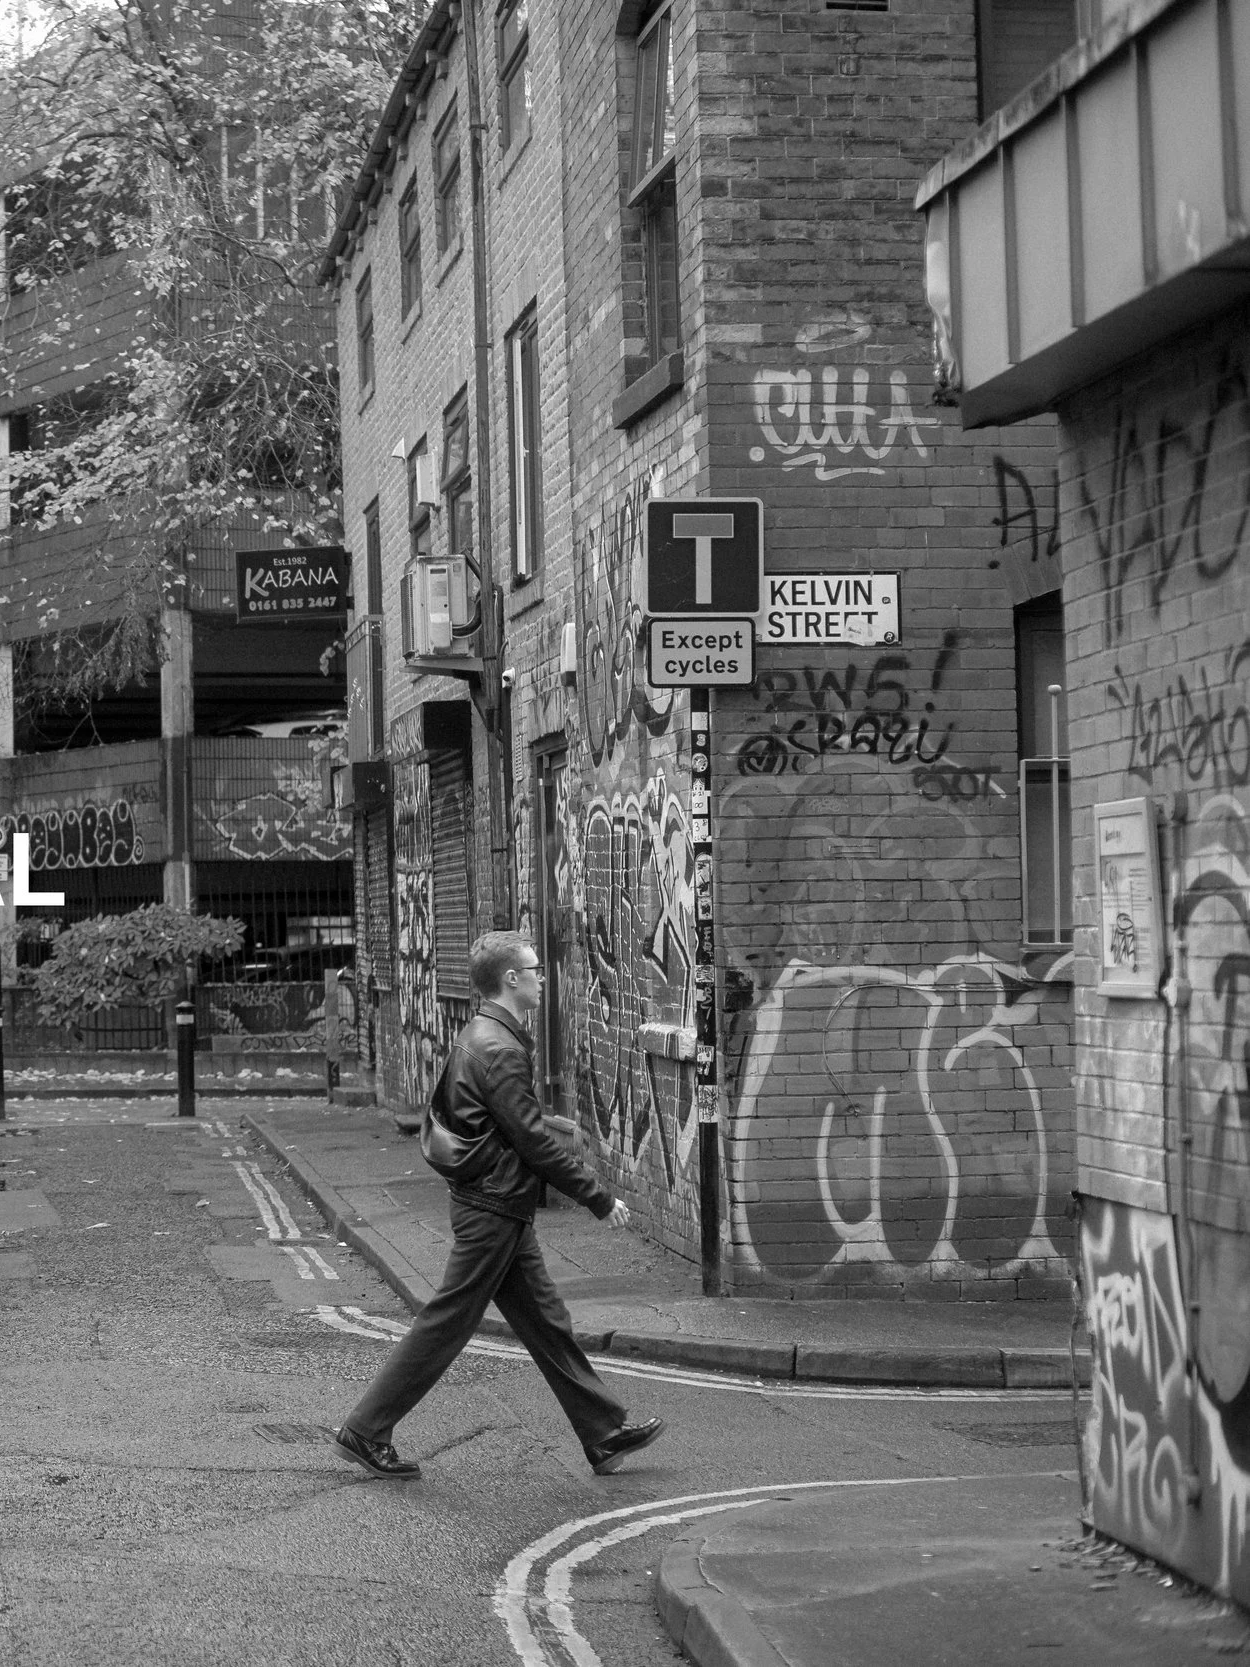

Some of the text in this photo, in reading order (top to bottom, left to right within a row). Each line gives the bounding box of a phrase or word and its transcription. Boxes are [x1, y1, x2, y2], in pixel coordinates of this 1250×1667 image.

[273, 556, 308, 566] Est.1982
[244, 566, 339, 599] KABANA
[769, 579, 873, 606] KELVIN
[248, 596, 337, 611] 0161 835 2447
[661, 629, 744, 652] Except
[664, 655, 740, 678] cycles
